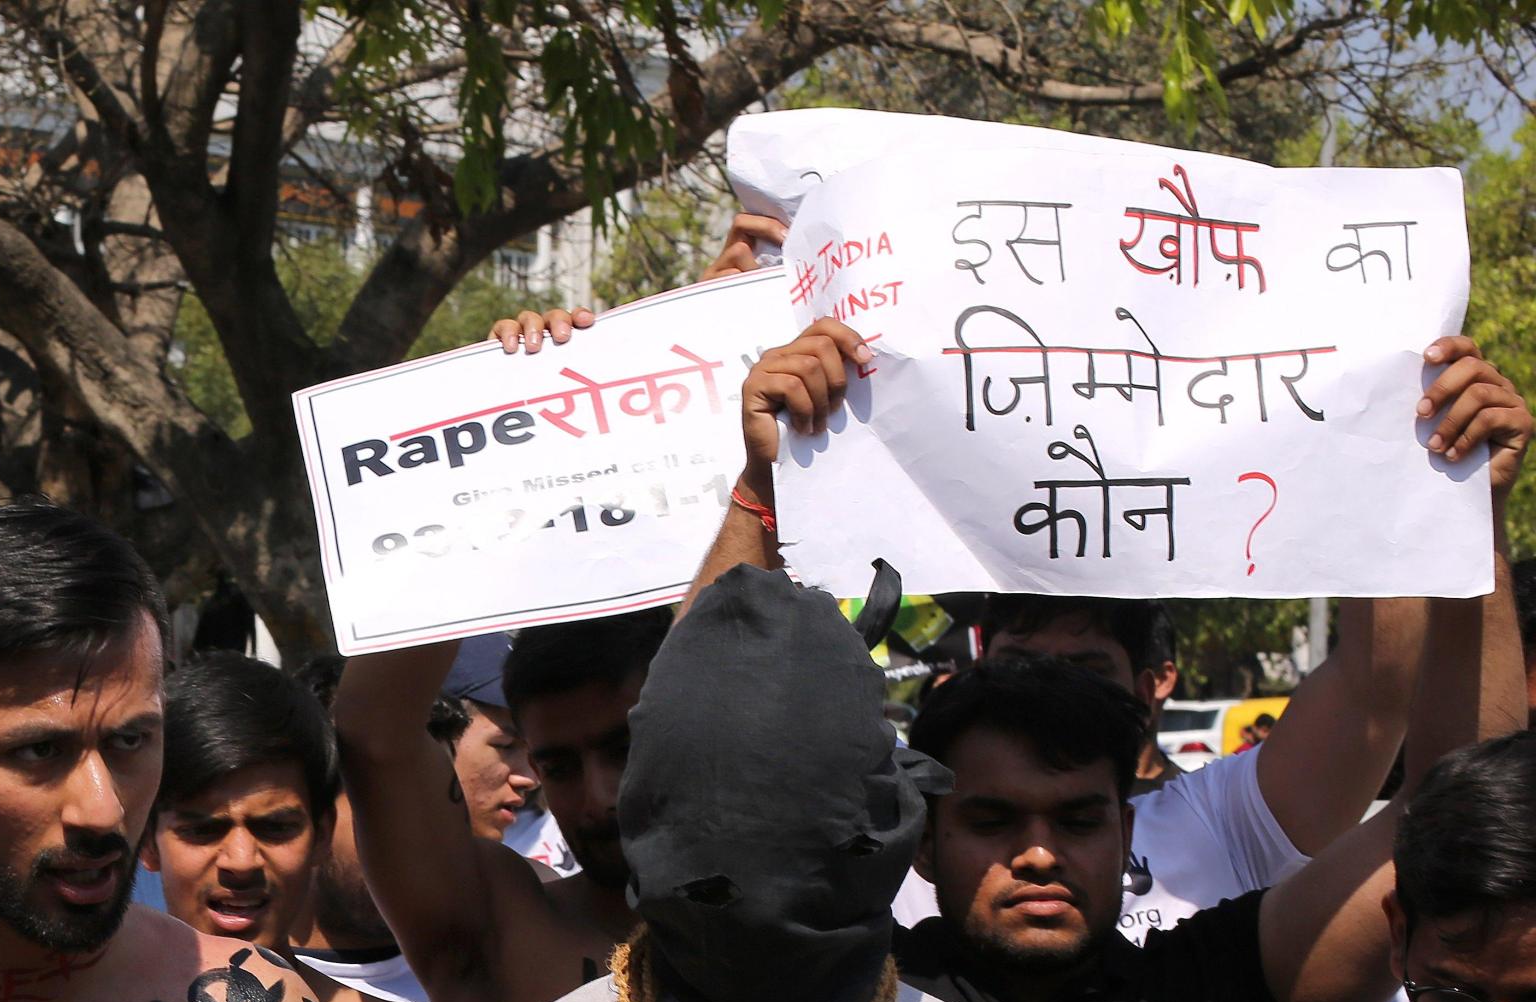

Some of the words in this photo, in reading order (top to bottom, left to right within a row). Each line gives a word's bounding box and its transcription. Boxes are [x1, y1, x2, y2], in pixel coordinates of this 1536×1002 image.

[789, 232, 893, 306] #INDIA
[952, 201, 1072, 285] इस
[1326, 220, 1418, 284] का
[1014, 425, 1191, 562] कौन
[1237, 471, 1278, 577] ?
